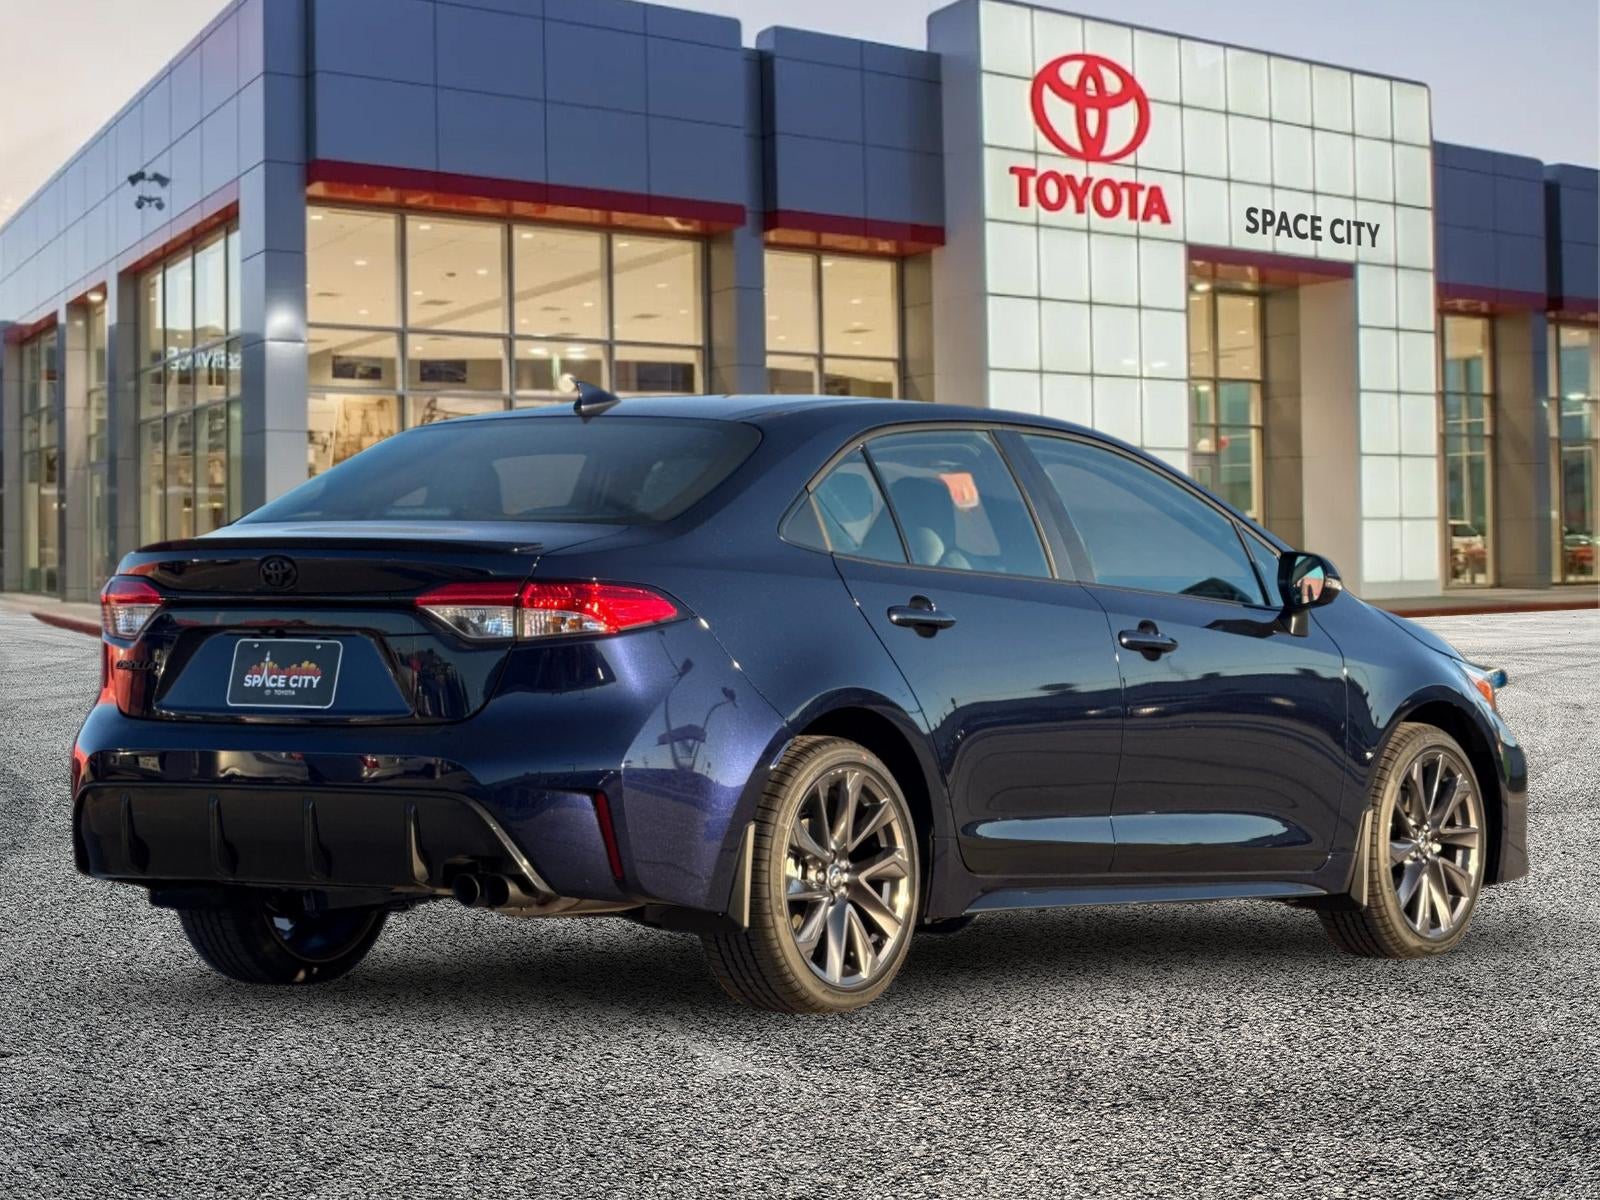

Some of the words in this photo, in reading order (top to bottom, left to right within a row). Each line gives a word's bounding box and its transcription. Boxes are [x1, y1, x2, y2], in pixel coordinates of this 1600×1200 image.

[1010, 167, 1170, 224] TOYOTA
[1245, 207, 1323, 241] SPACE
[1329, 218, 1380, 247] CITY
[243, 674, 286, 688] SPACE
[288, 675, 321, 689] CITY
